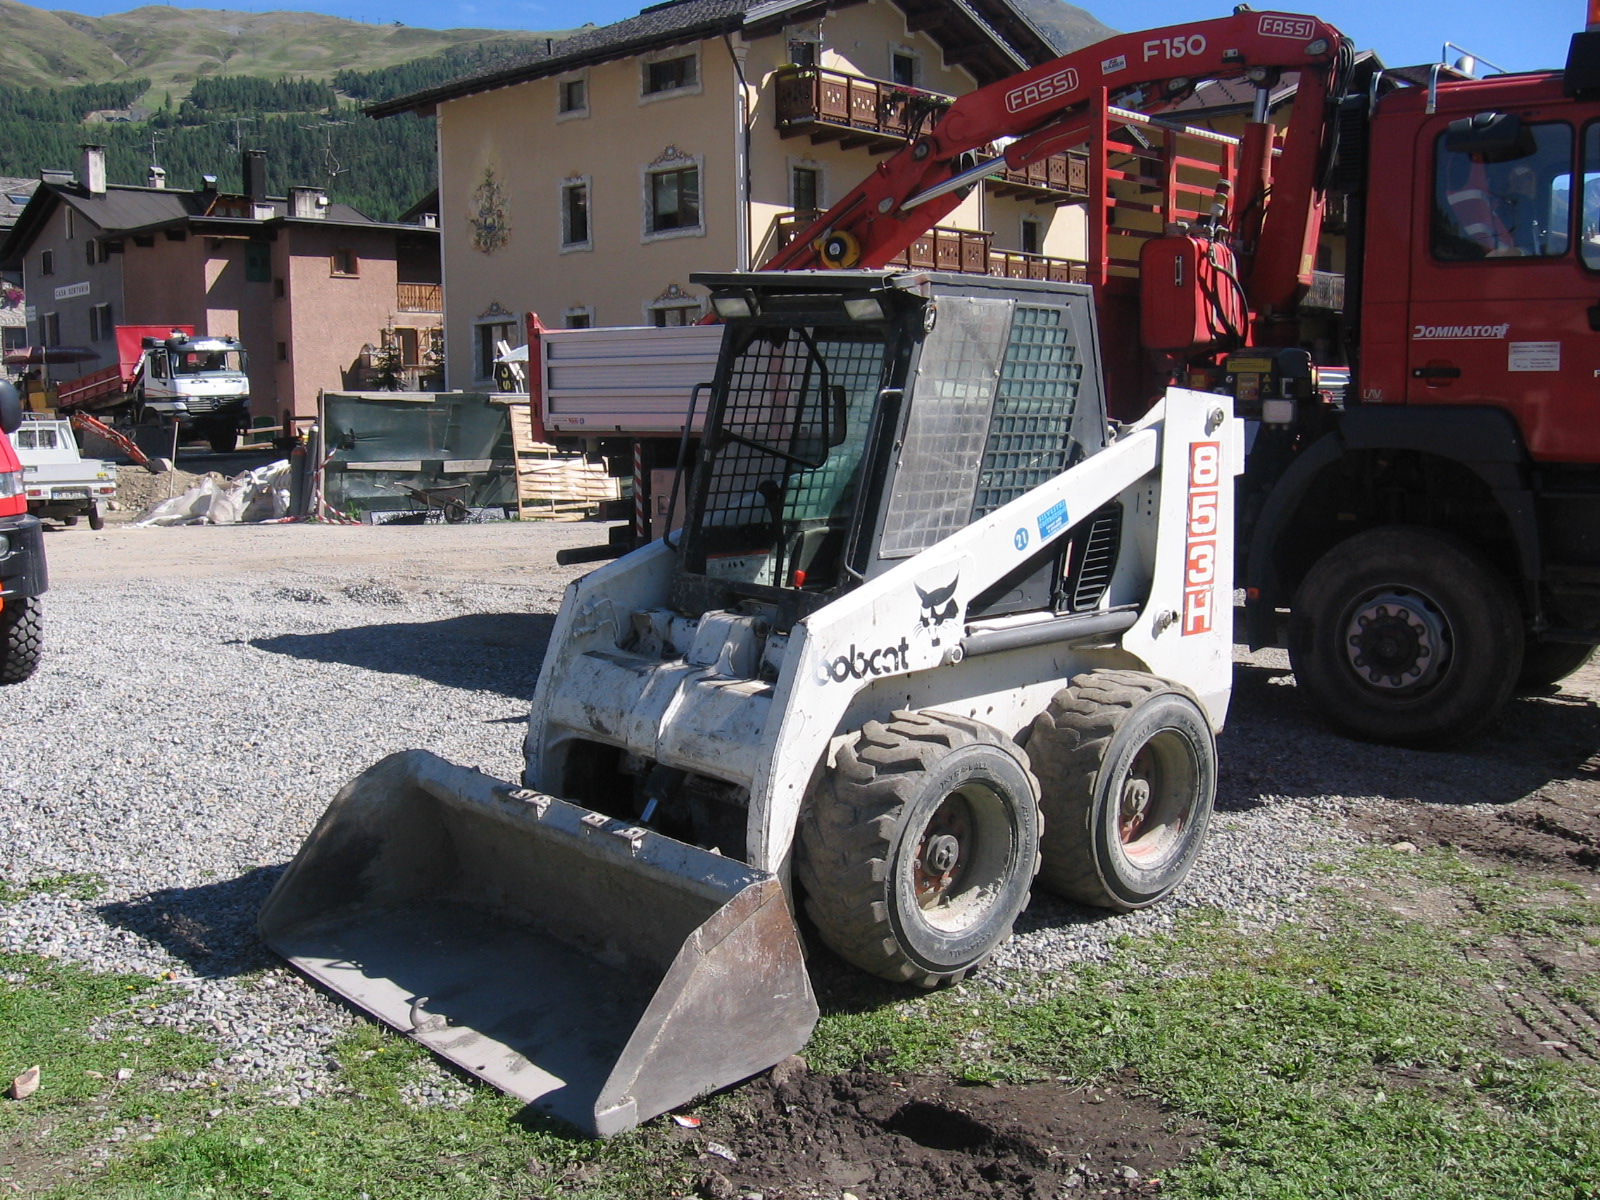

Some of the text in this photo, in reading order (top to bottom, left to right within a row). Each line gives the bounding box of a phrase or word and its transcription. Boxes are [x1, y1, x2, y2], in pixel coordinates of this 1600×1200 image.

[1262, 17, 1312, 37] FASSI
[1143, 34, 1206, 62] F150
[1010, 71, 1077, 110] FASSI
[1413, 325, 1505, 338] DOMINATOR
[1016, 530, 1027, 549] 21
[1187, 446, 1219, 632] 853H
